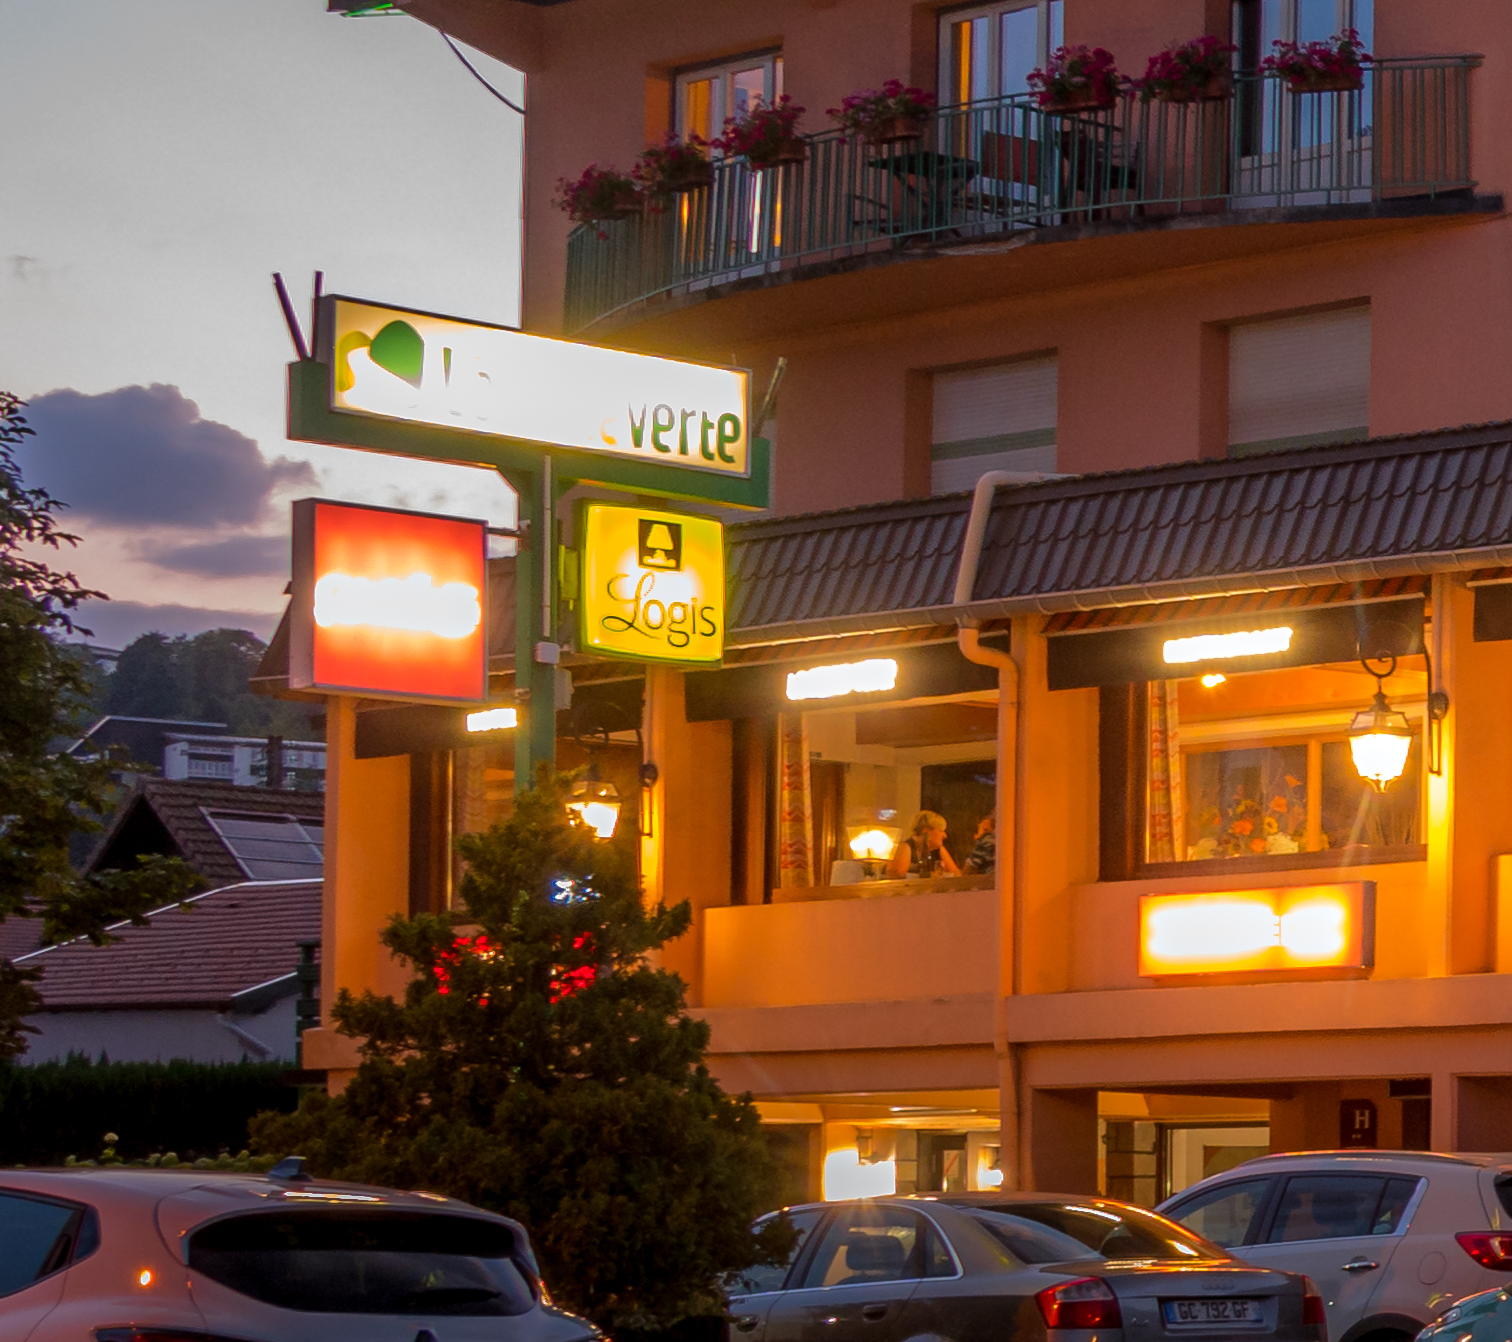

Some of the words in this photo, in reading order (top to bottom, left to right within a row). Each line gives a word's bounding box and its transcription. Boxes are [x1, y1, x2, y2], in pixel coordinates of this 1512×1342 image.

[627, 400, 741, 464] verte
[601, 570, 717, 648] Logis
[1354, 1109, 1370, 1129] H
